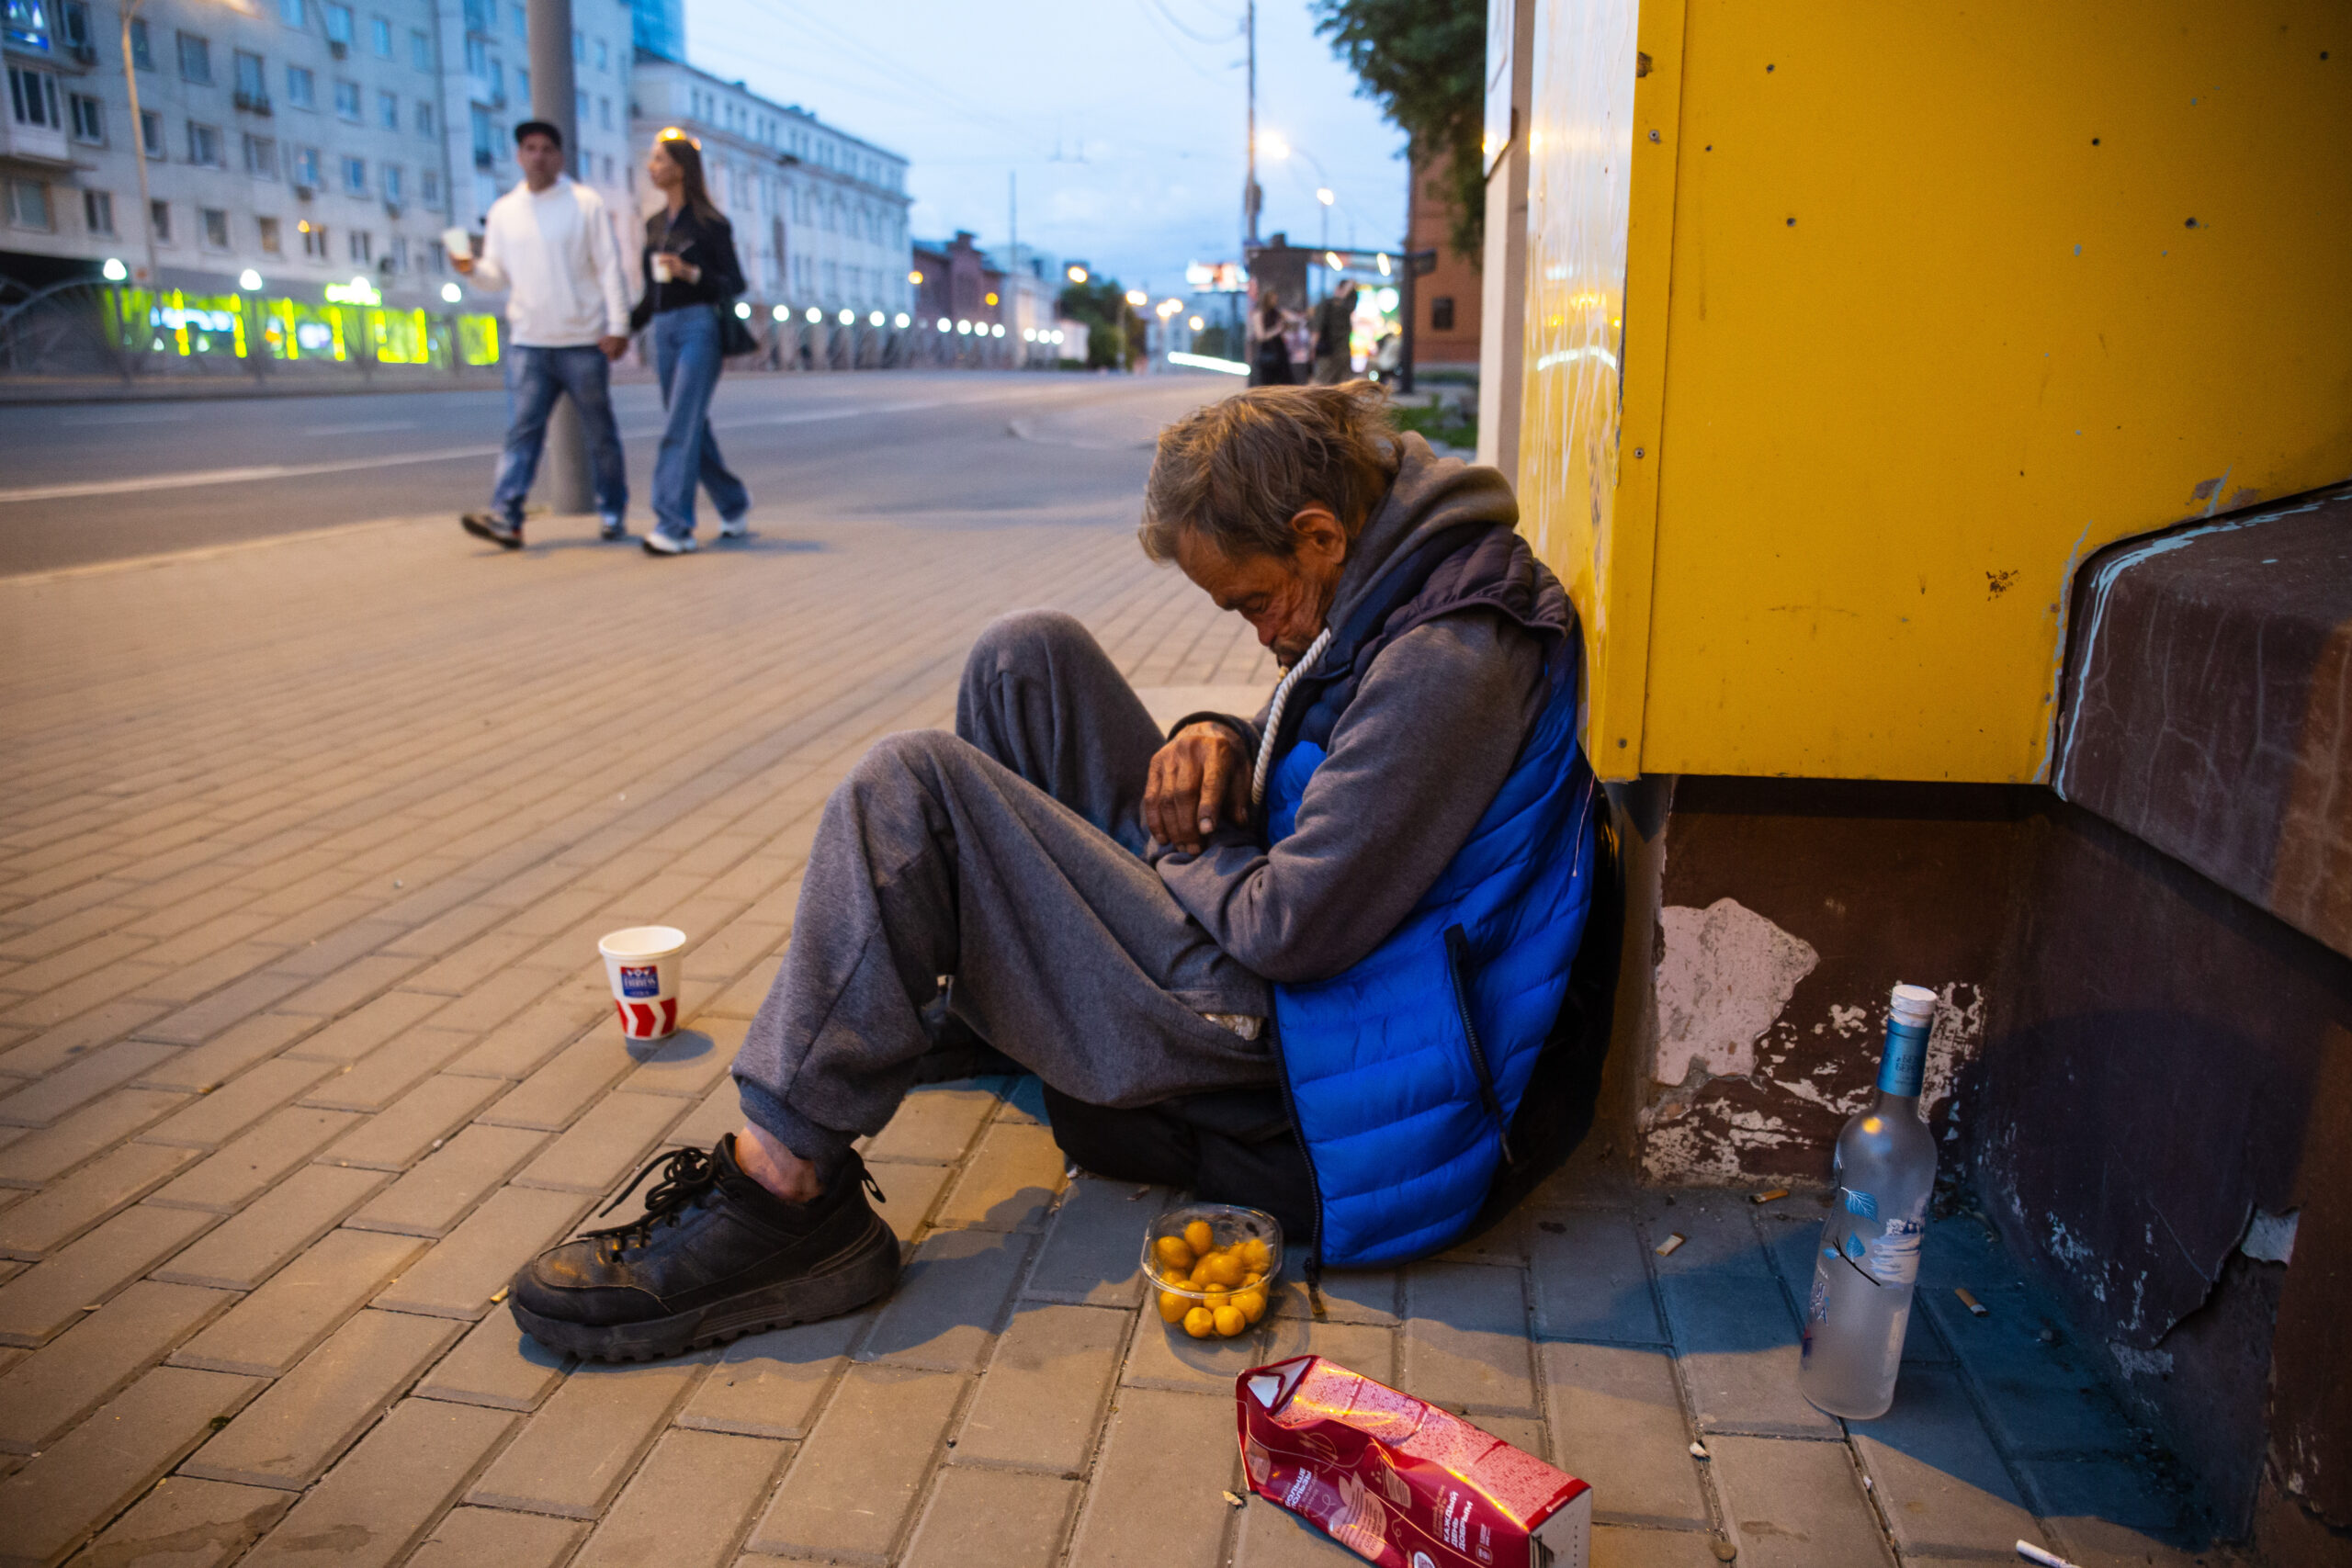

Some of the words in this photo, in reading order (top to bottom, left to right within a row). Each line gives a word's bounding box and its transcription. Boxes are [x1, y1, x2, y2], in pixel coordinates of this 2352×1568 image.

[1443, 1491, 1459, 1543] КАЖДЫЙ
[1451, 1517, 1459, 1548] ДЕНЬ
[1458, 1500, 1474, 1552] ДОБРЫМ
